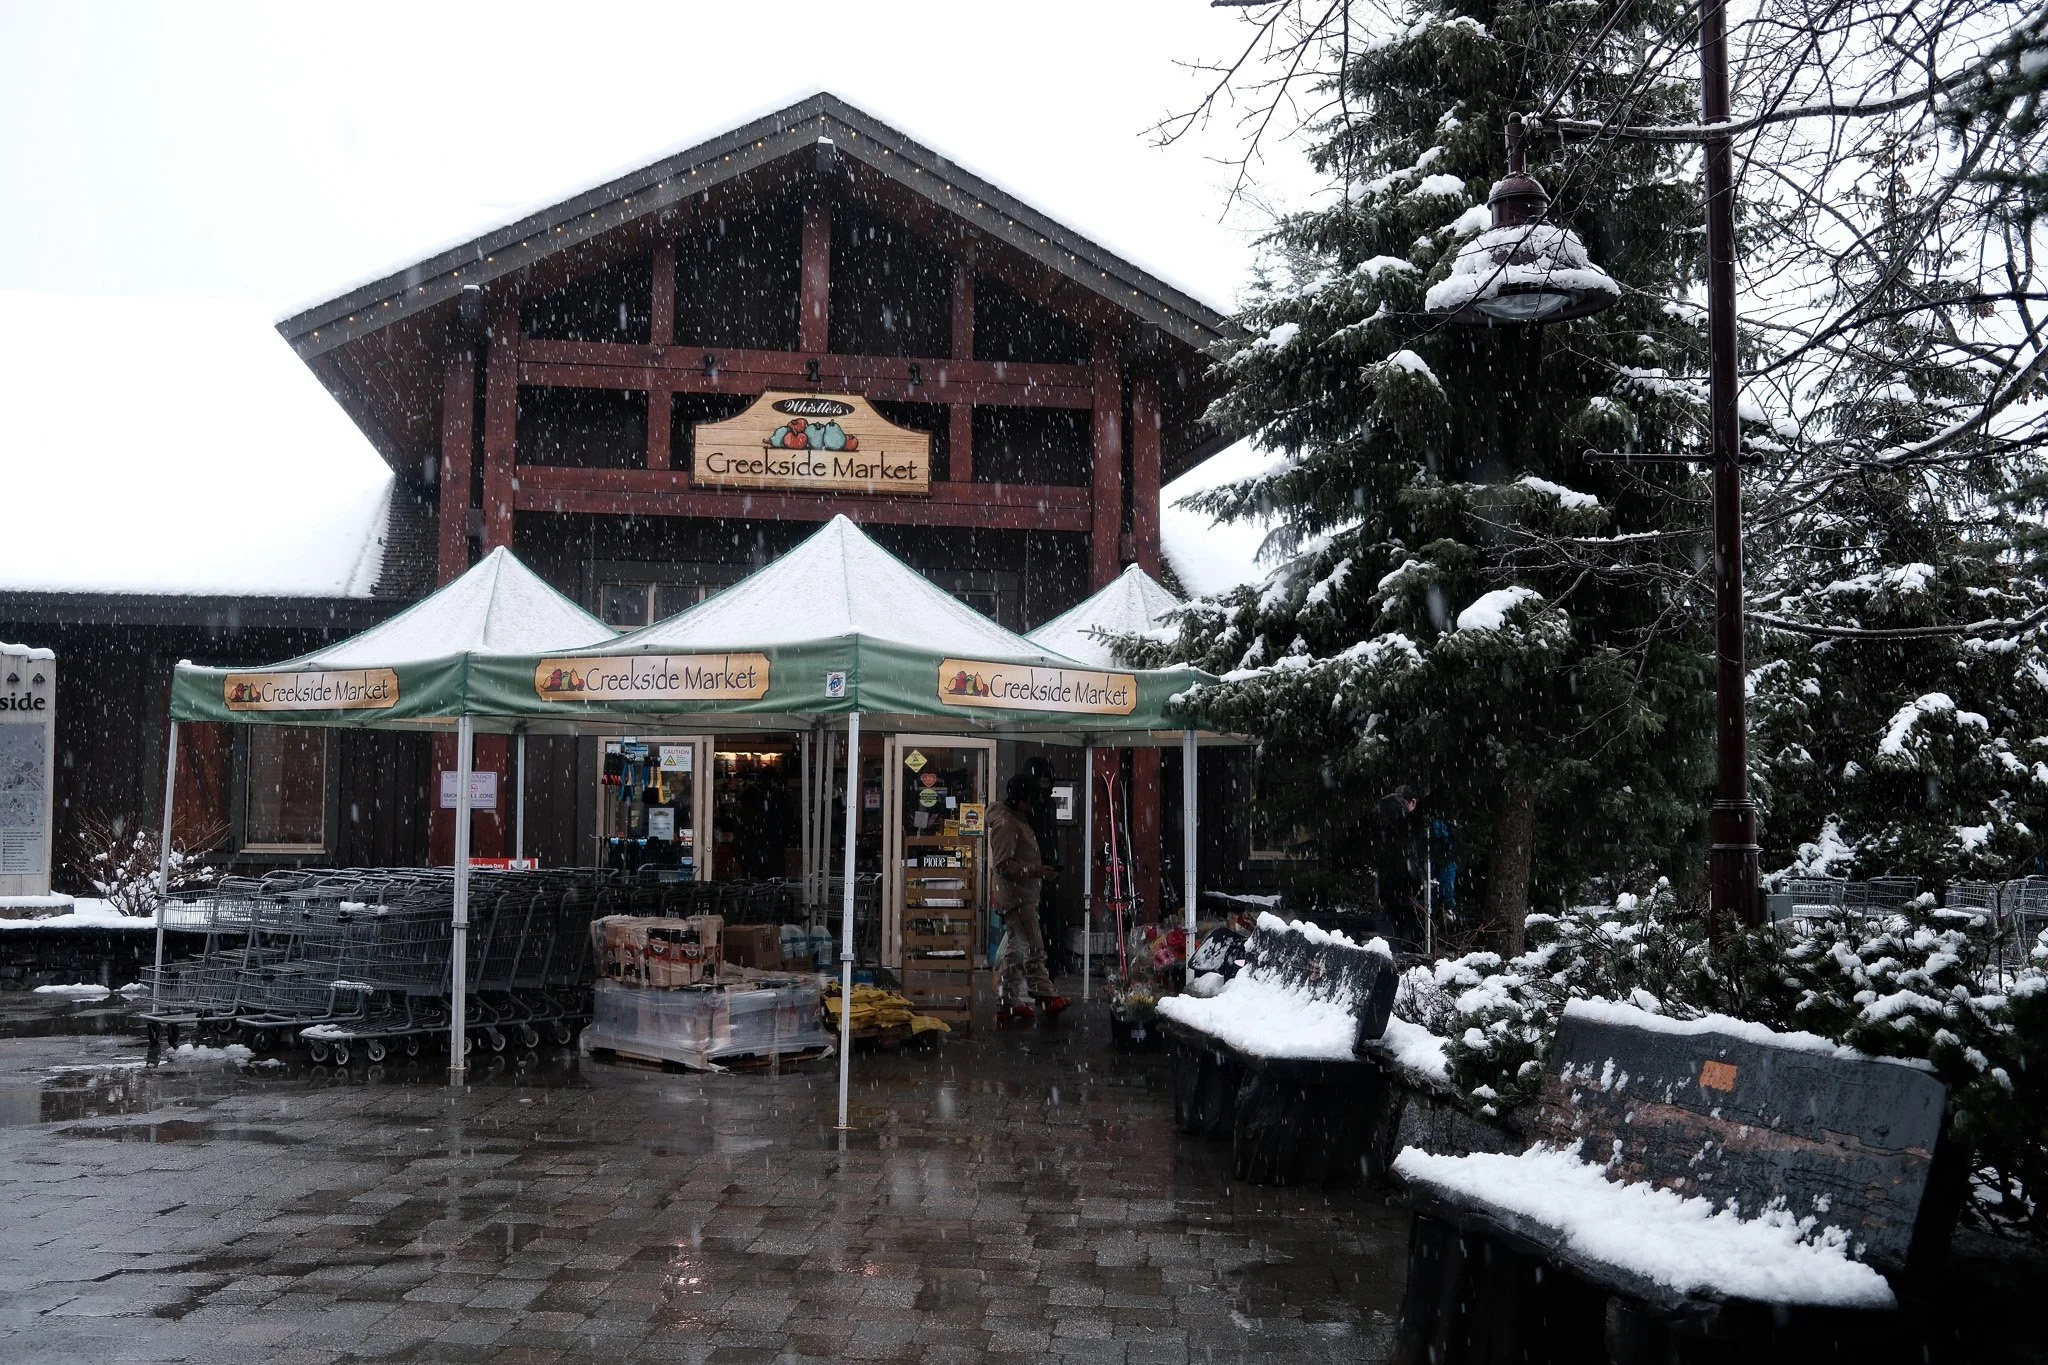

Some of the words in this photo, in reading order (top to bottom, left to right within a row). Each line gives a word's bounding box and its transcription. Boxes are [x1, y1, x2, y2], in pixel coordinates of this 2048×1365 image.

[783, 398, 843, 415] Whistler's
[706, 447, 827, 477] Creekside
[833, 451, 918, 480] Market
[261, 673, 332, 703] Creekside
[334, 671, 389, 700] Market
[585, 657, 680, 692] Creekside
[684, 655, 757, 690] Market
[990, 668, 1071, 703] Creekside
[1074, 675, 1128, 706] Market
